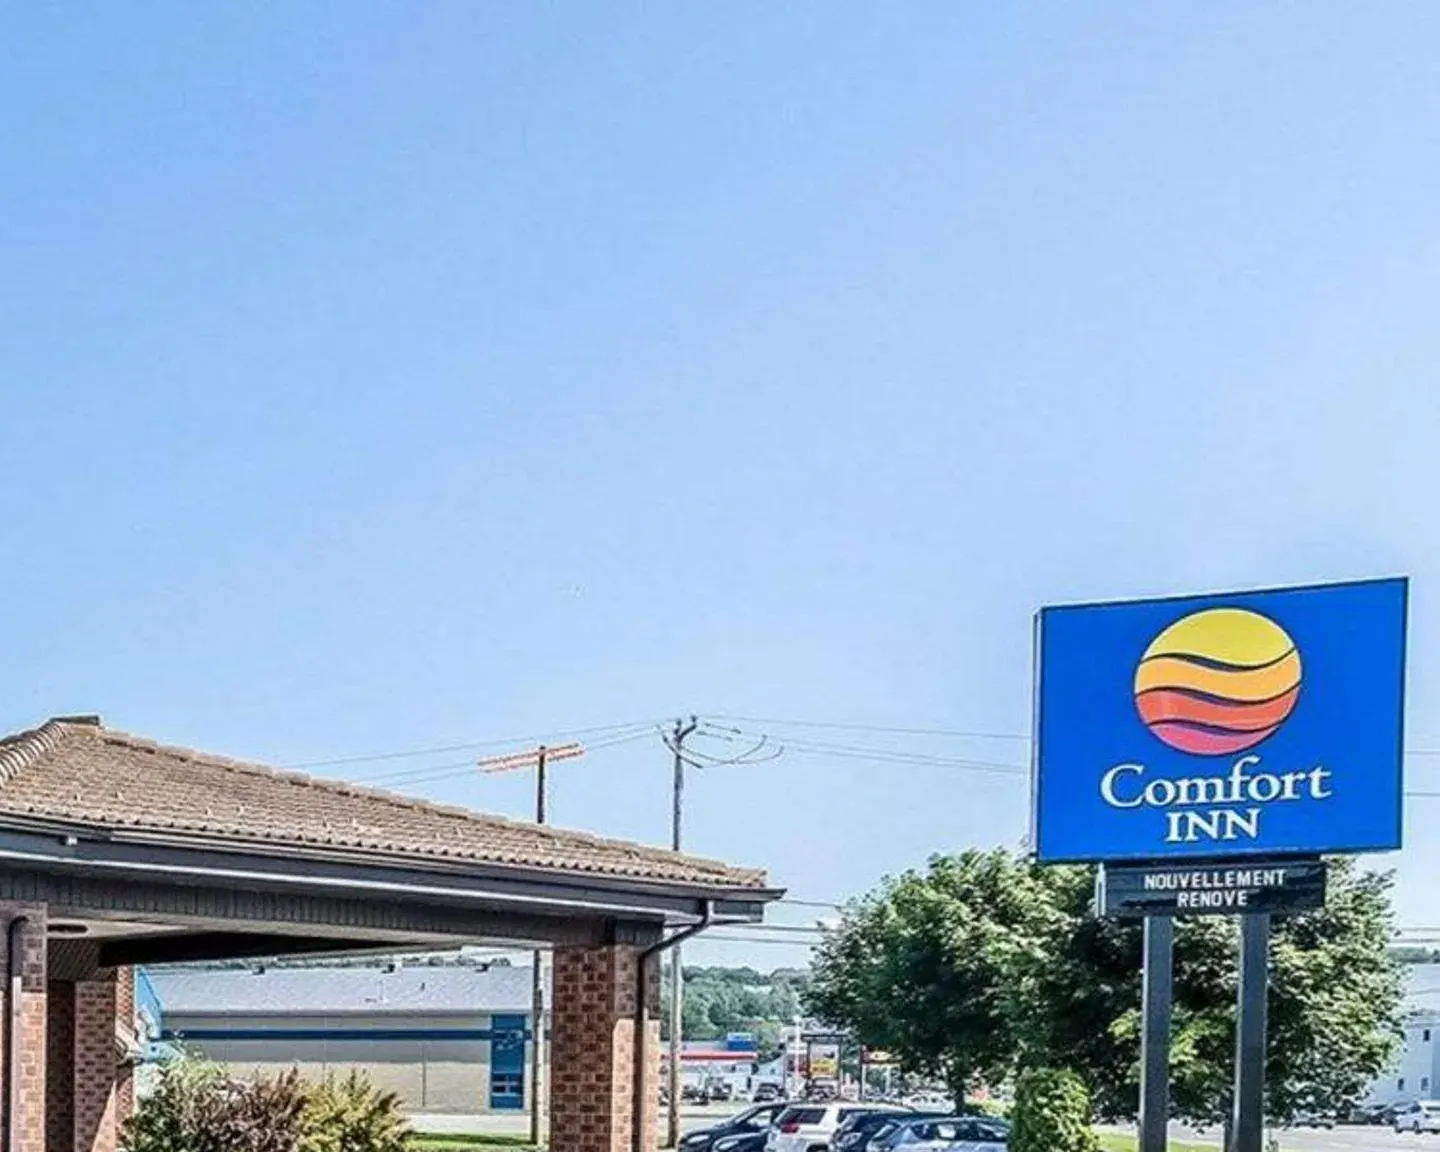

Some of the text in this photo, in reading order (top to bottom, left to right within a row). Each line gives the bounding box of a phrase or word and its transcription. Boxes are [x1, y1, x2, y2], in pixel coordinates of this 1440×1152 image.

[1100, 755, 1332, 808] Comfort
[1164, 807, 1262, 842] INN
[1144, 868, 1287, 891] NOUVELLEMENT
[1177, 890, 1249, 908] RENOVE
